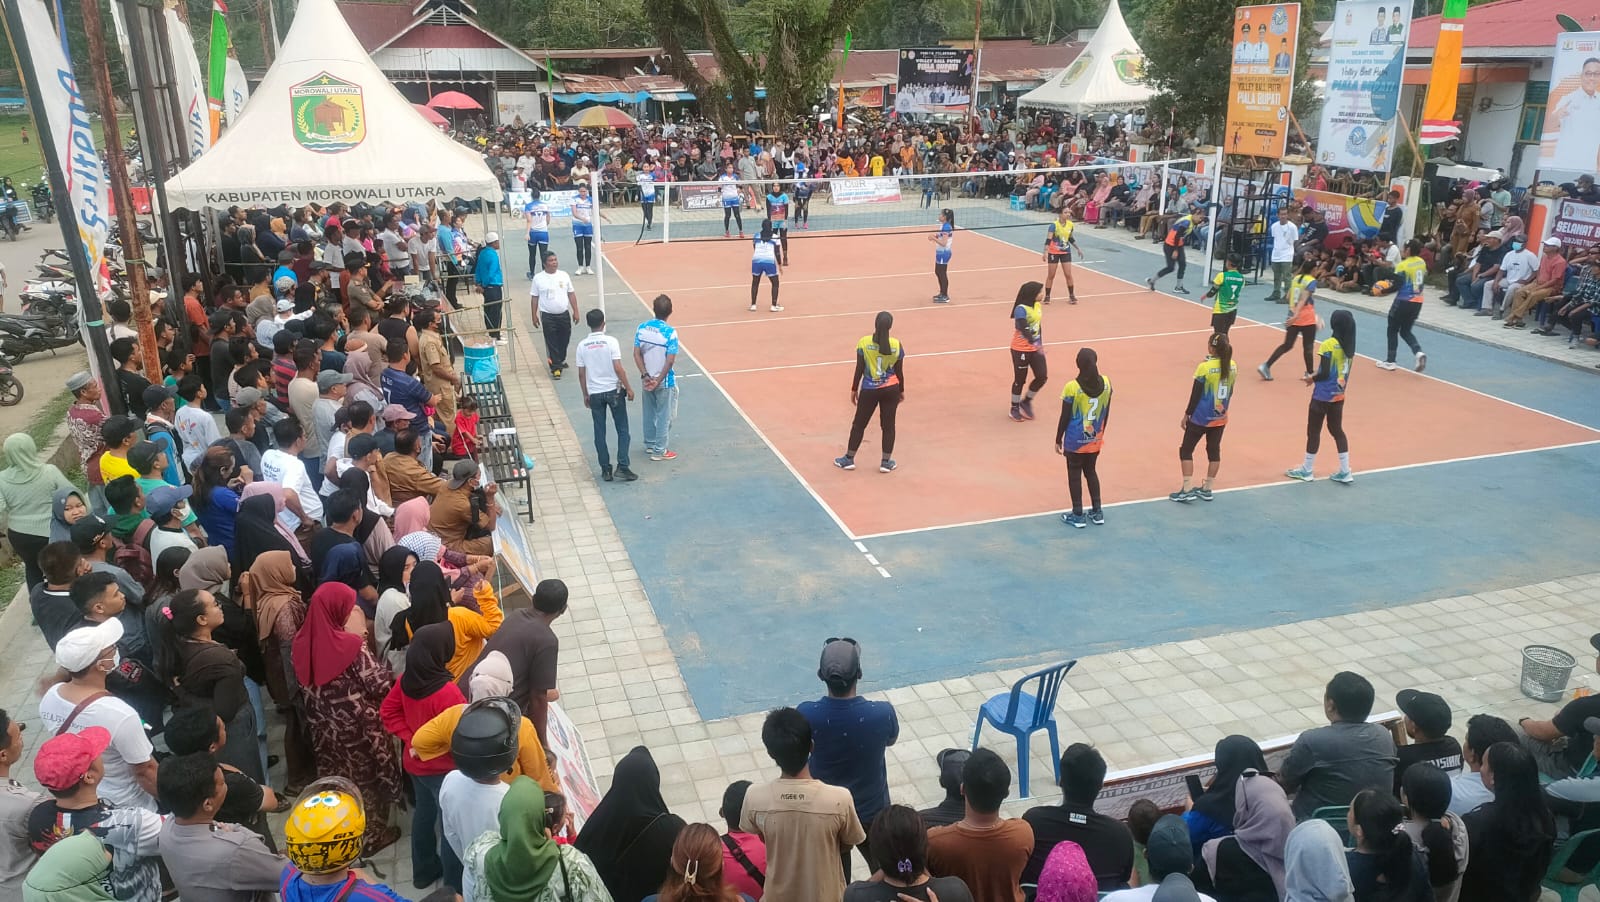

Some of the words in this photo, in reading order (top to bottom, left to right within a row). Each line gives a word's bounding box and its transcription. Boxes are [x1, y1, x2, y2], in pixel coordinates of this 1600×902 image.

[205, 191, 302, 204] KABUPATEN
[306, 188, 391, 201] MOROWALI
[395, 186, 446, 198] UTARA
[876, 356, 882, 376] 1
[1087, 397, 1099, 421] 2
